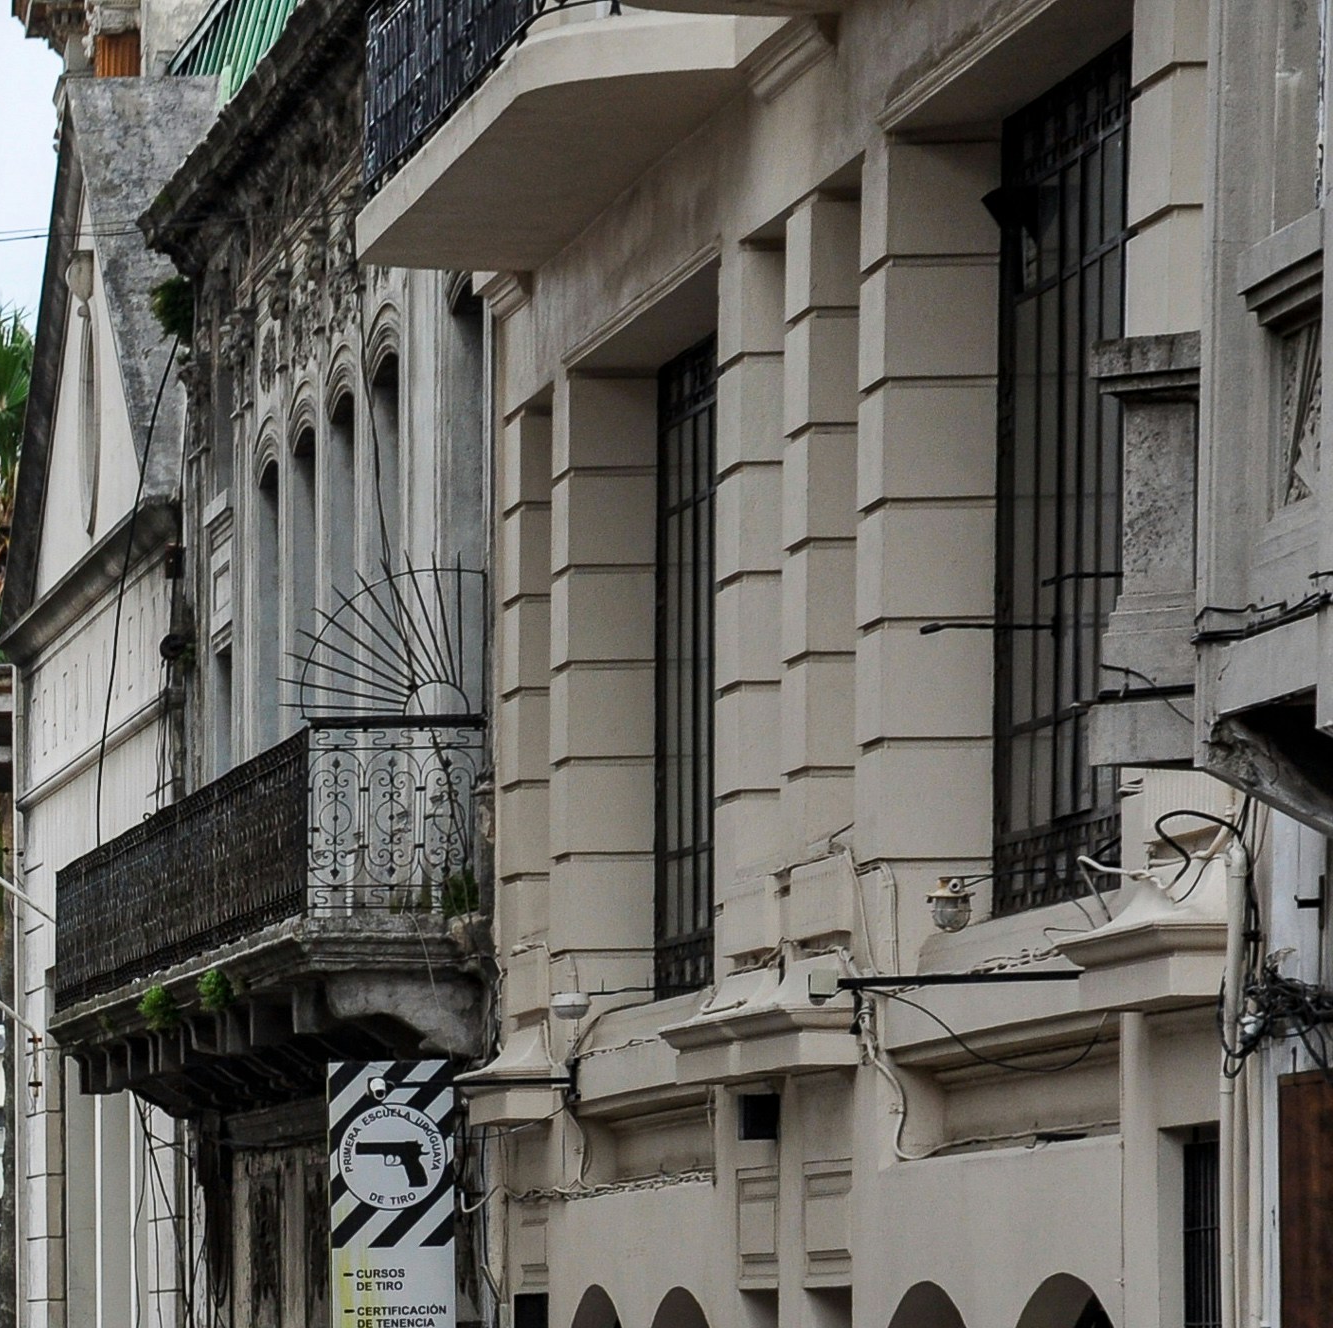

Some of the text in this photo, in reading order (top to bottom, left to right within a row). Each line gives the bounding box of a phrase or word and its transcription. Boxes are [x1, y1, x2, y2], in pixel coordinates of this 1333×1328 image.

[343, 1107, 441, 1173] PRIMERA ESCUELA URUGUAYA
[369, 1191, 417, 1205] DE TIRO
[356, 1268, 406, 1279] CURSOS
[356, 1281, 403, 1292] DE TIRO
[357, 1304, 447, 1316] CERTIFICACIÓN
[357, 1317, 435, 1328] DE TENENCIA
